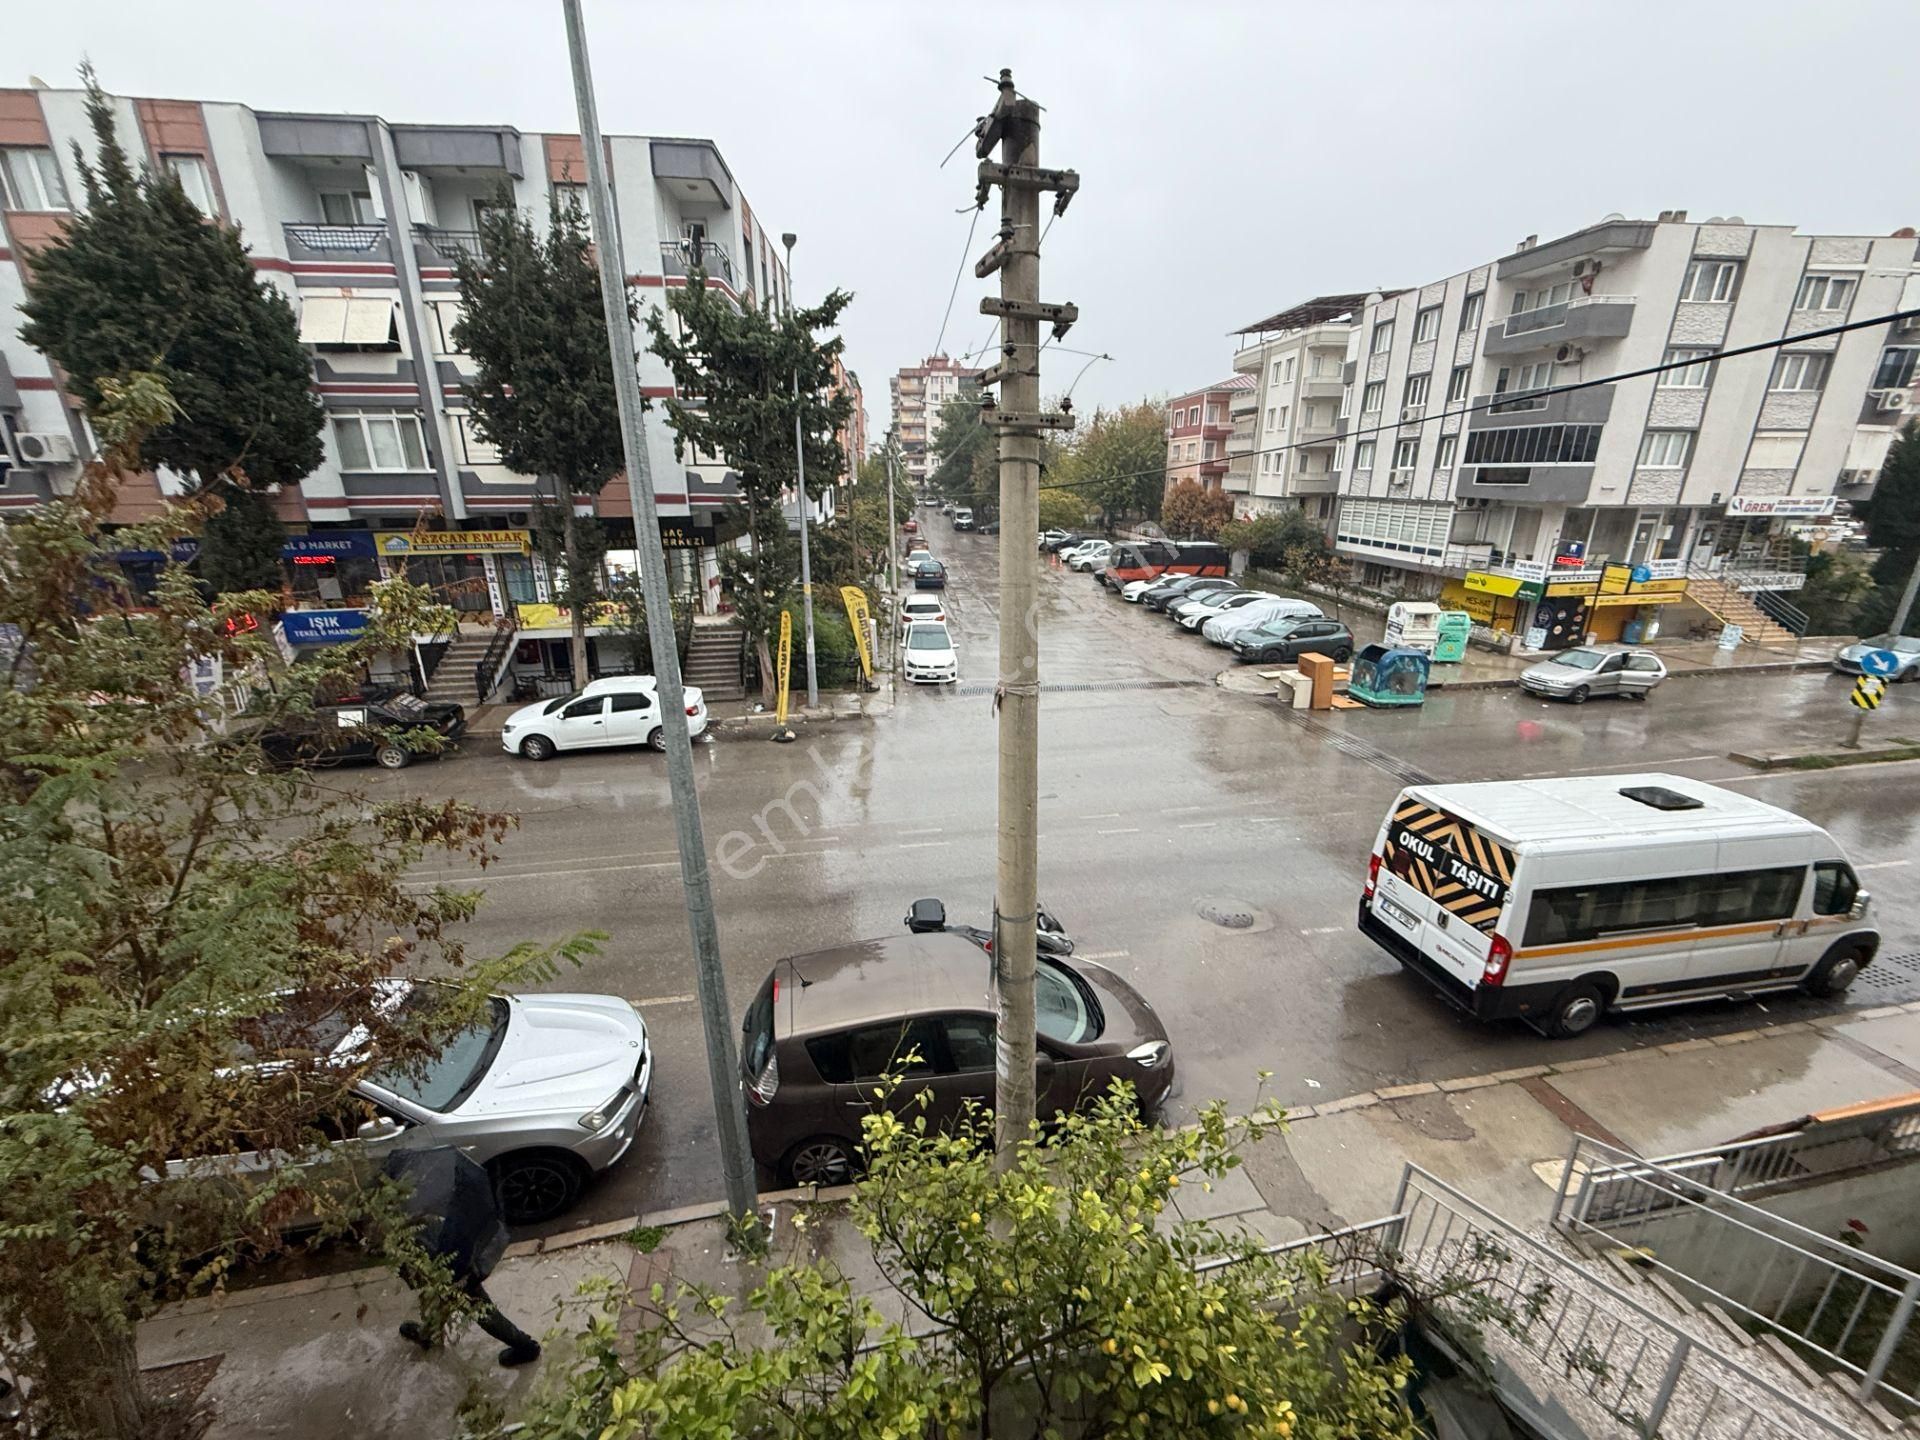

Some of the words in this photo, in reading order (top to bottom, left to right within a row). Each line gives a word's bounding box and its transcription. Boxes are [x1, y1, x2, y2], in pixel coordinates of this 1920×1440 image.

[473, 532, 522, 542] EMLAK
[662, 536, 705, 546] ERKEZİ
[309, 541, 352, 550] MARKET
[309, 617, 340, 630] IŞIK
[1400, 831, 1434, 862] OKUL
[1451, 859, 1500, 899] TAŞITI
